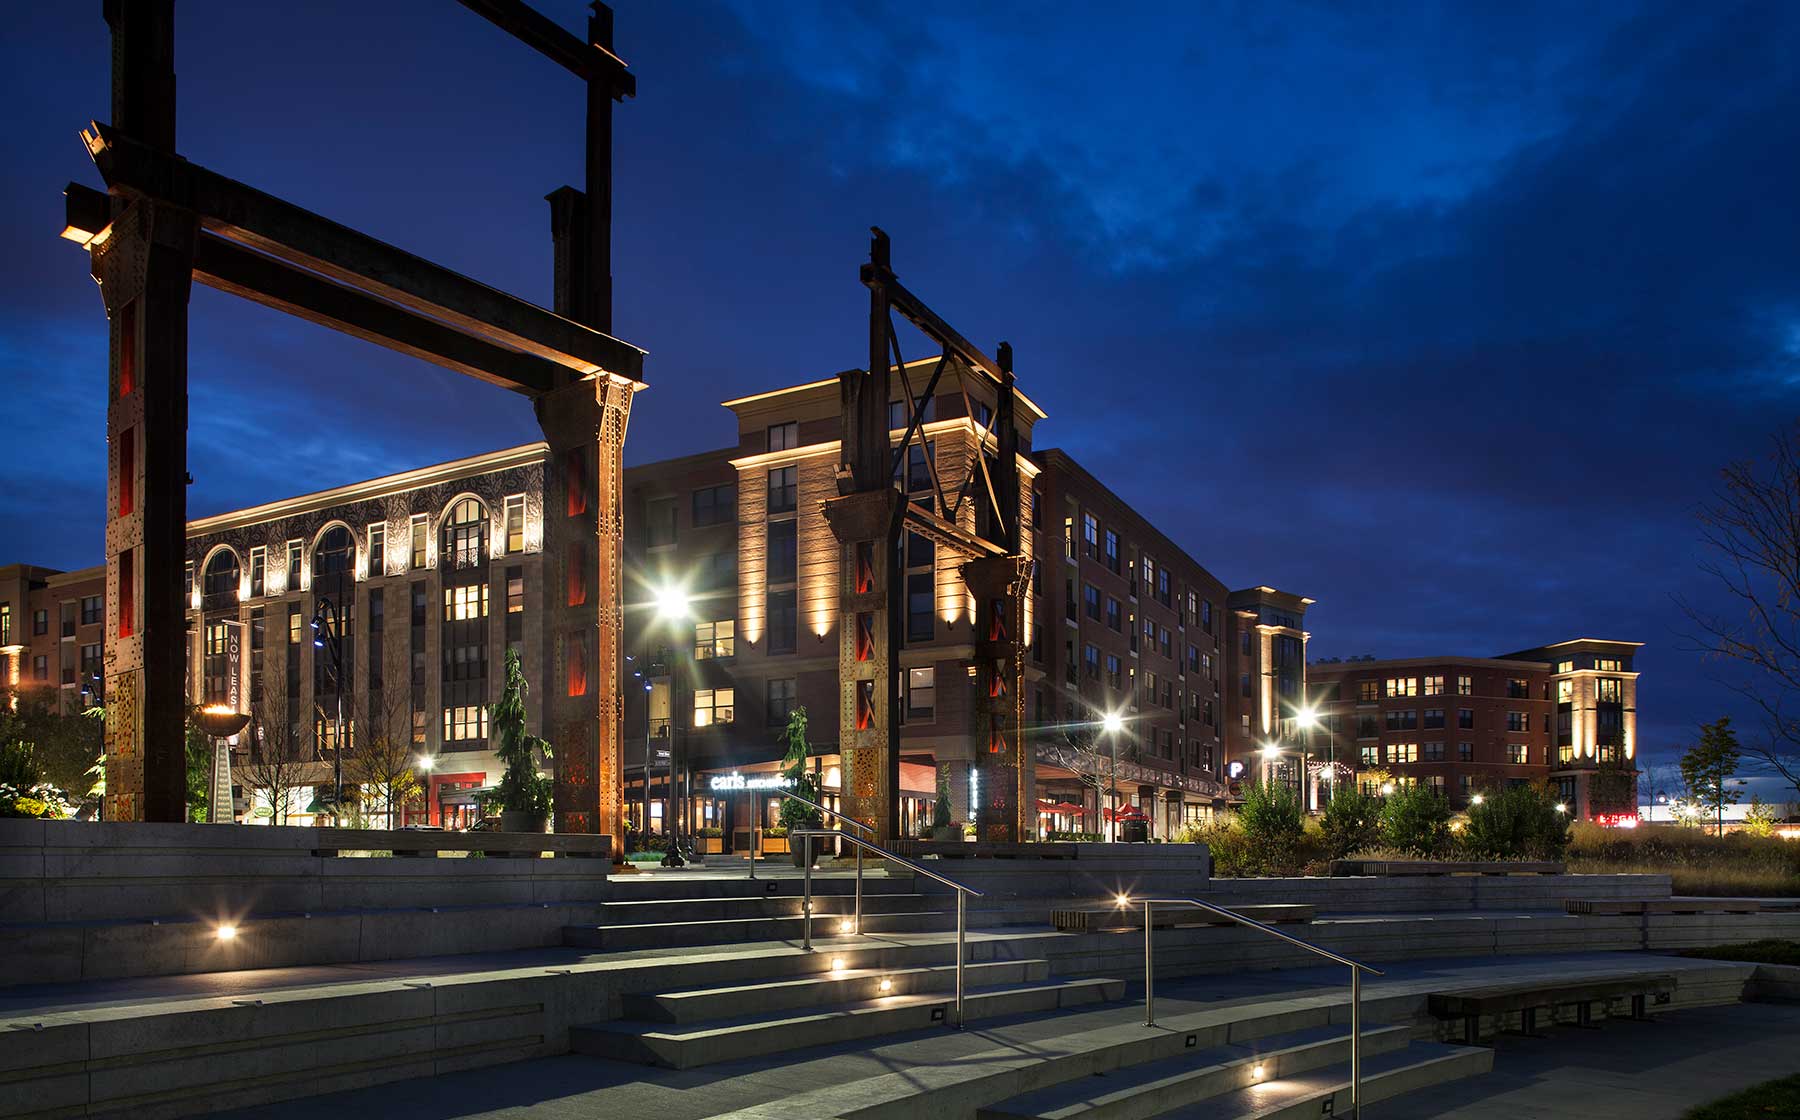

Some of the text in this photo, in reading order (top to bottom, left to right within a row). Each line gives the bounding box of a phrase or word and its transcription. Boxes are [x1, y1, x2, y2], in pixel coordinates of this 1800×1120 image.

[229, 634, 239, 713] NOW LEASI
[710, 770, 745, 790] earls
[1230, 762, 1243, 778] P
